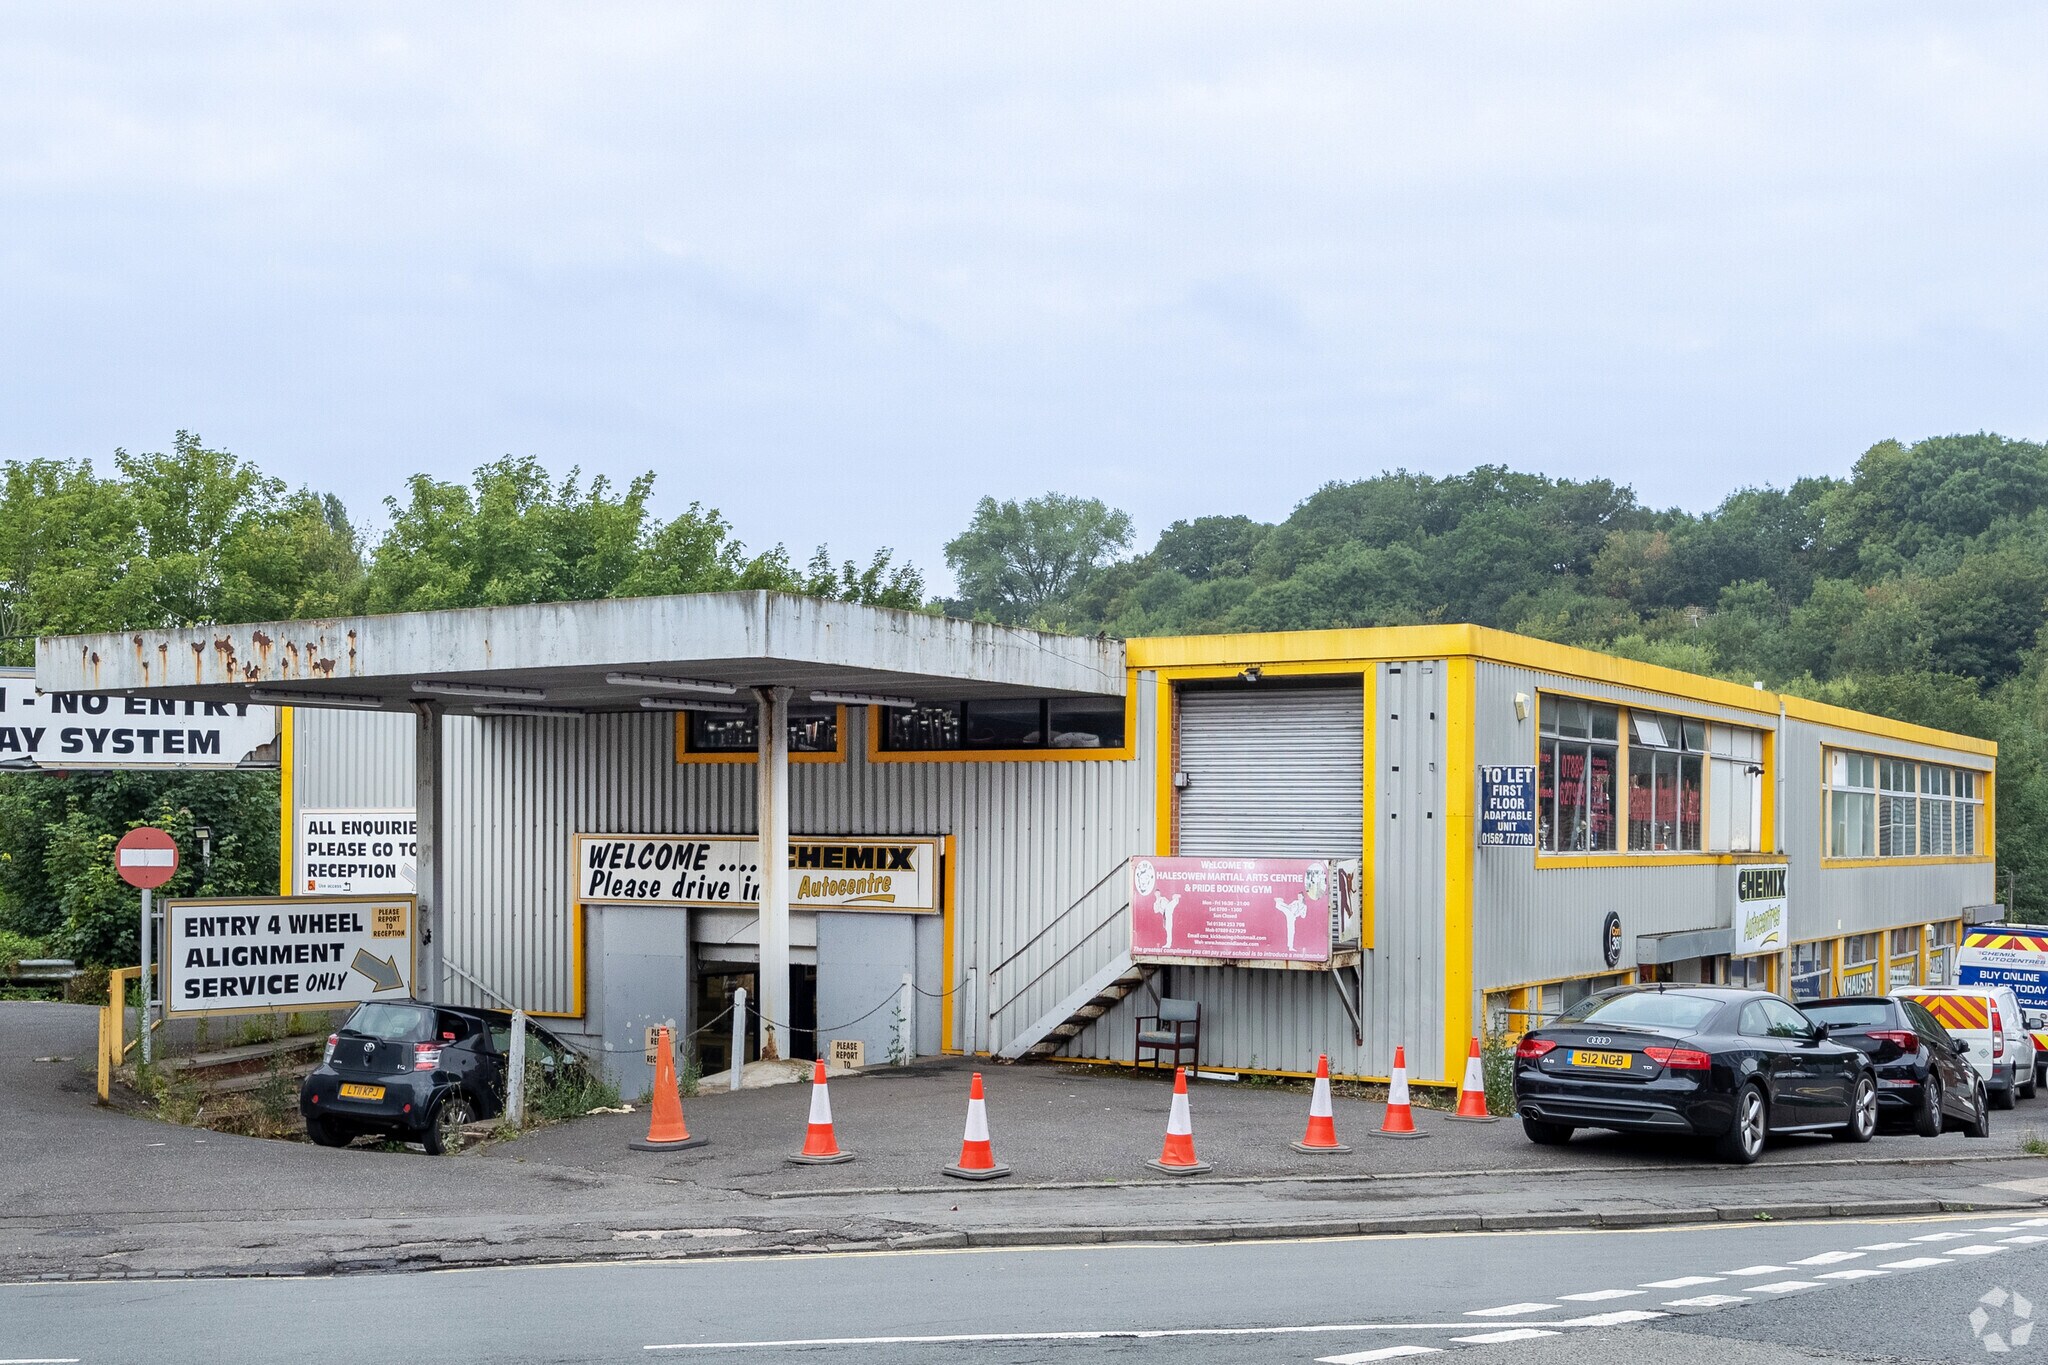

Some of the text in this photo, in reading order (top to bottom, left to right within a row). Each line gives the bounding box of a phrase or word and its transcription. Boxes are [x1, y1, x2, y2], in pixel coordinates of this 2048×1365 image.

[51, 693, 108, 714] NO
[60, 727, 221, 755] SYSTEM
[1484, 768, 1533, 783] TO LET
[1492, 784, 1523, 796] FIRST
[1490, 798, 1525, 810] FLOOR
[1484, 811, 1532, 820] ADAPTABLE
[308, 821, 336, 835] ALL
[1497, 822, 1517, 832] UNIT
[1482, 833, 1533, 845] 01562 777769
[308, 842, 417, 857] PLEASE GO TO
[588, 842, 710, 870] WELCOME
[1200, 860, 1255, 869] WELCOME TO
[308, 864, 396, 878] RECEPTION
[1156, 872, 1205, 880] HALESOWEN
[1207, 872, 1244, 881] MARTIAL
[1246, 873, 1269, 882] ARTS
[1270, 874, 1303, 883] CENTRE
[588, 869, 661, 898] Please
[672, 872, 730, 900] drive
[798, 872, 892, 899] Autocentre
[1184, 884, 1272, 894] & PRIDE BOXING GYM
[1738, 867, 1786, 903] CHEMIX
[184, 913, 363, 938] ENTRY 4 WHEEL
[184, 943, 345, 968] ALIGNMENT
[1981, 956, 2046, 965] AUTOCENTRES
[1980, 970, 2040, 982] BUY ONLINE
[184, 972, 348, 999] SERVICE ONLY
[2014, 984, 2047, 995] TODAY
[651, 1029, 670, 1037] PLEE
[837, 1042, 857, 1050] PLEASE
[836, 1051, 858, 1060] REPORT
[1581, 1053, 1597, 1064] S12
[1601, 1054, 1624, 1065] NGB
[843, 1061, 851, 1069] TO
